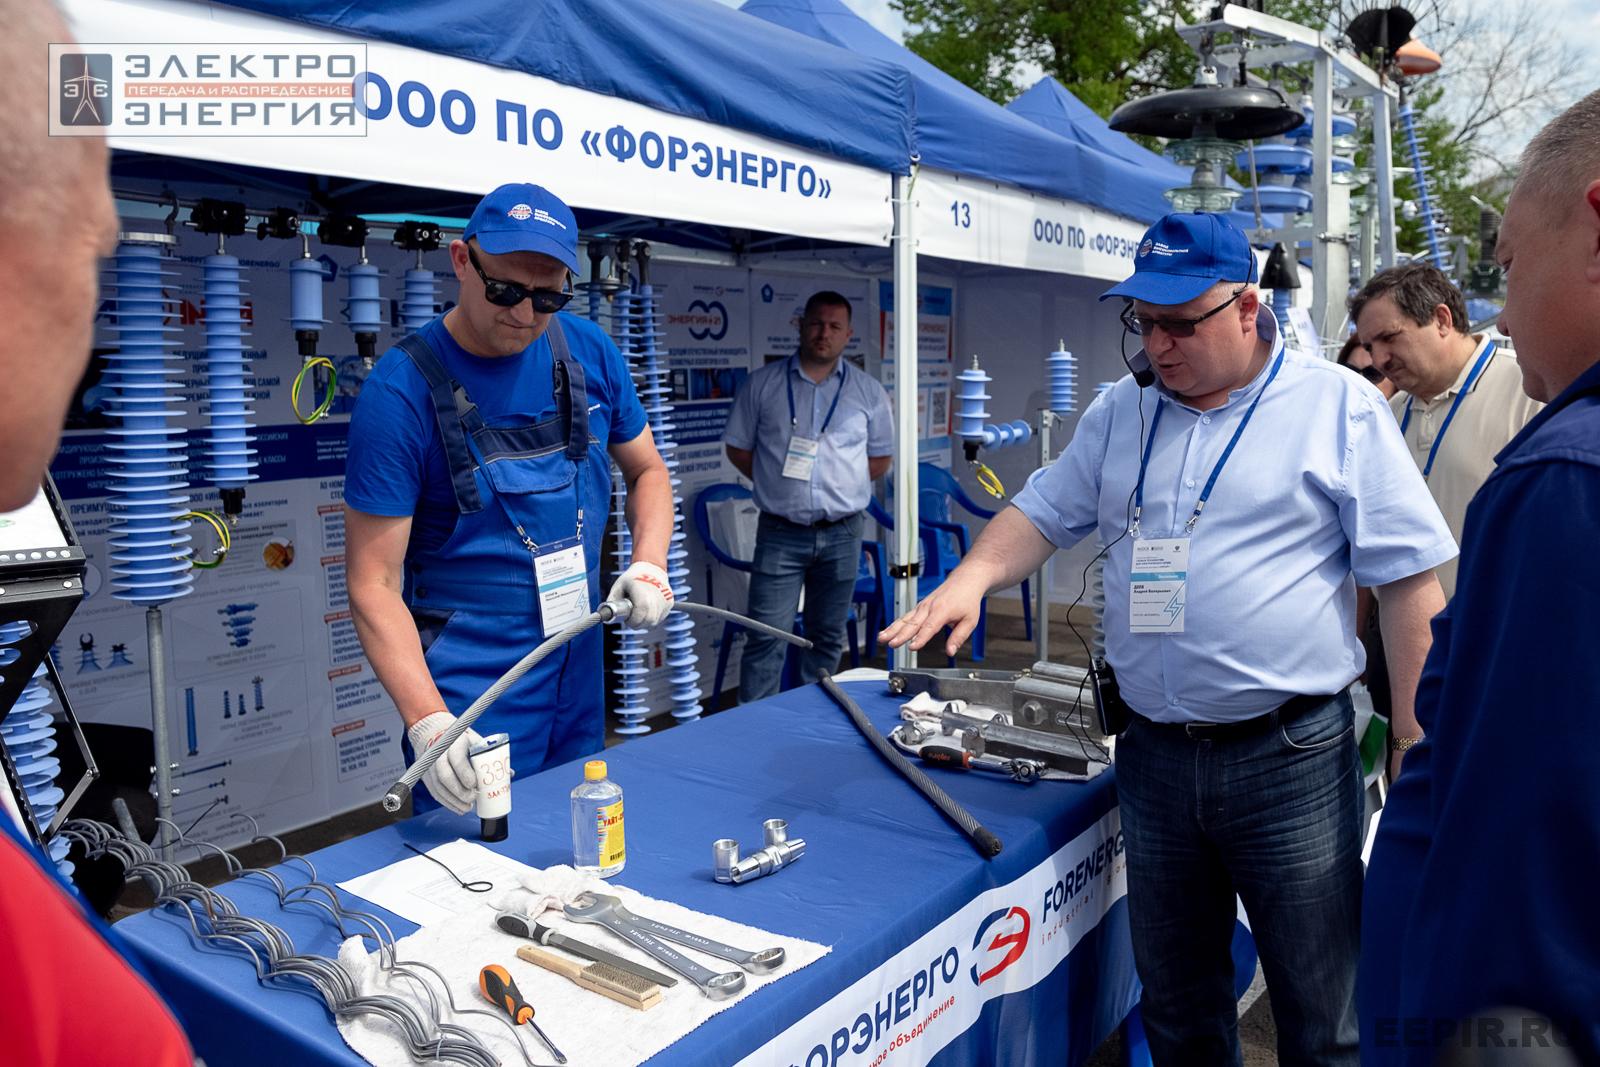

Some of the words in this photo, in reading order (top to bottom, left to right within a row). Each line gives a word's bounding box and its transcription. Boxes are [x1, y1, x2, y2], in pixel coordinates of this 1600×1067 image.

[353, 71, 476, 135] ООО
[496, 99, 563, 151] ПО
[580, 124, 831, 199] «ФОРЭНЕРГО»
[951, 200, 971, 228] 13
[1034, 218, 1063, 245] ООО
[1067, 225, 1085, 250] ПО
[1043, 830, 1126, 924] FORENERG
[788, 946, 959, 1067] ОРЭНЕРГО
[890, 995, 955, 1052] объединение
